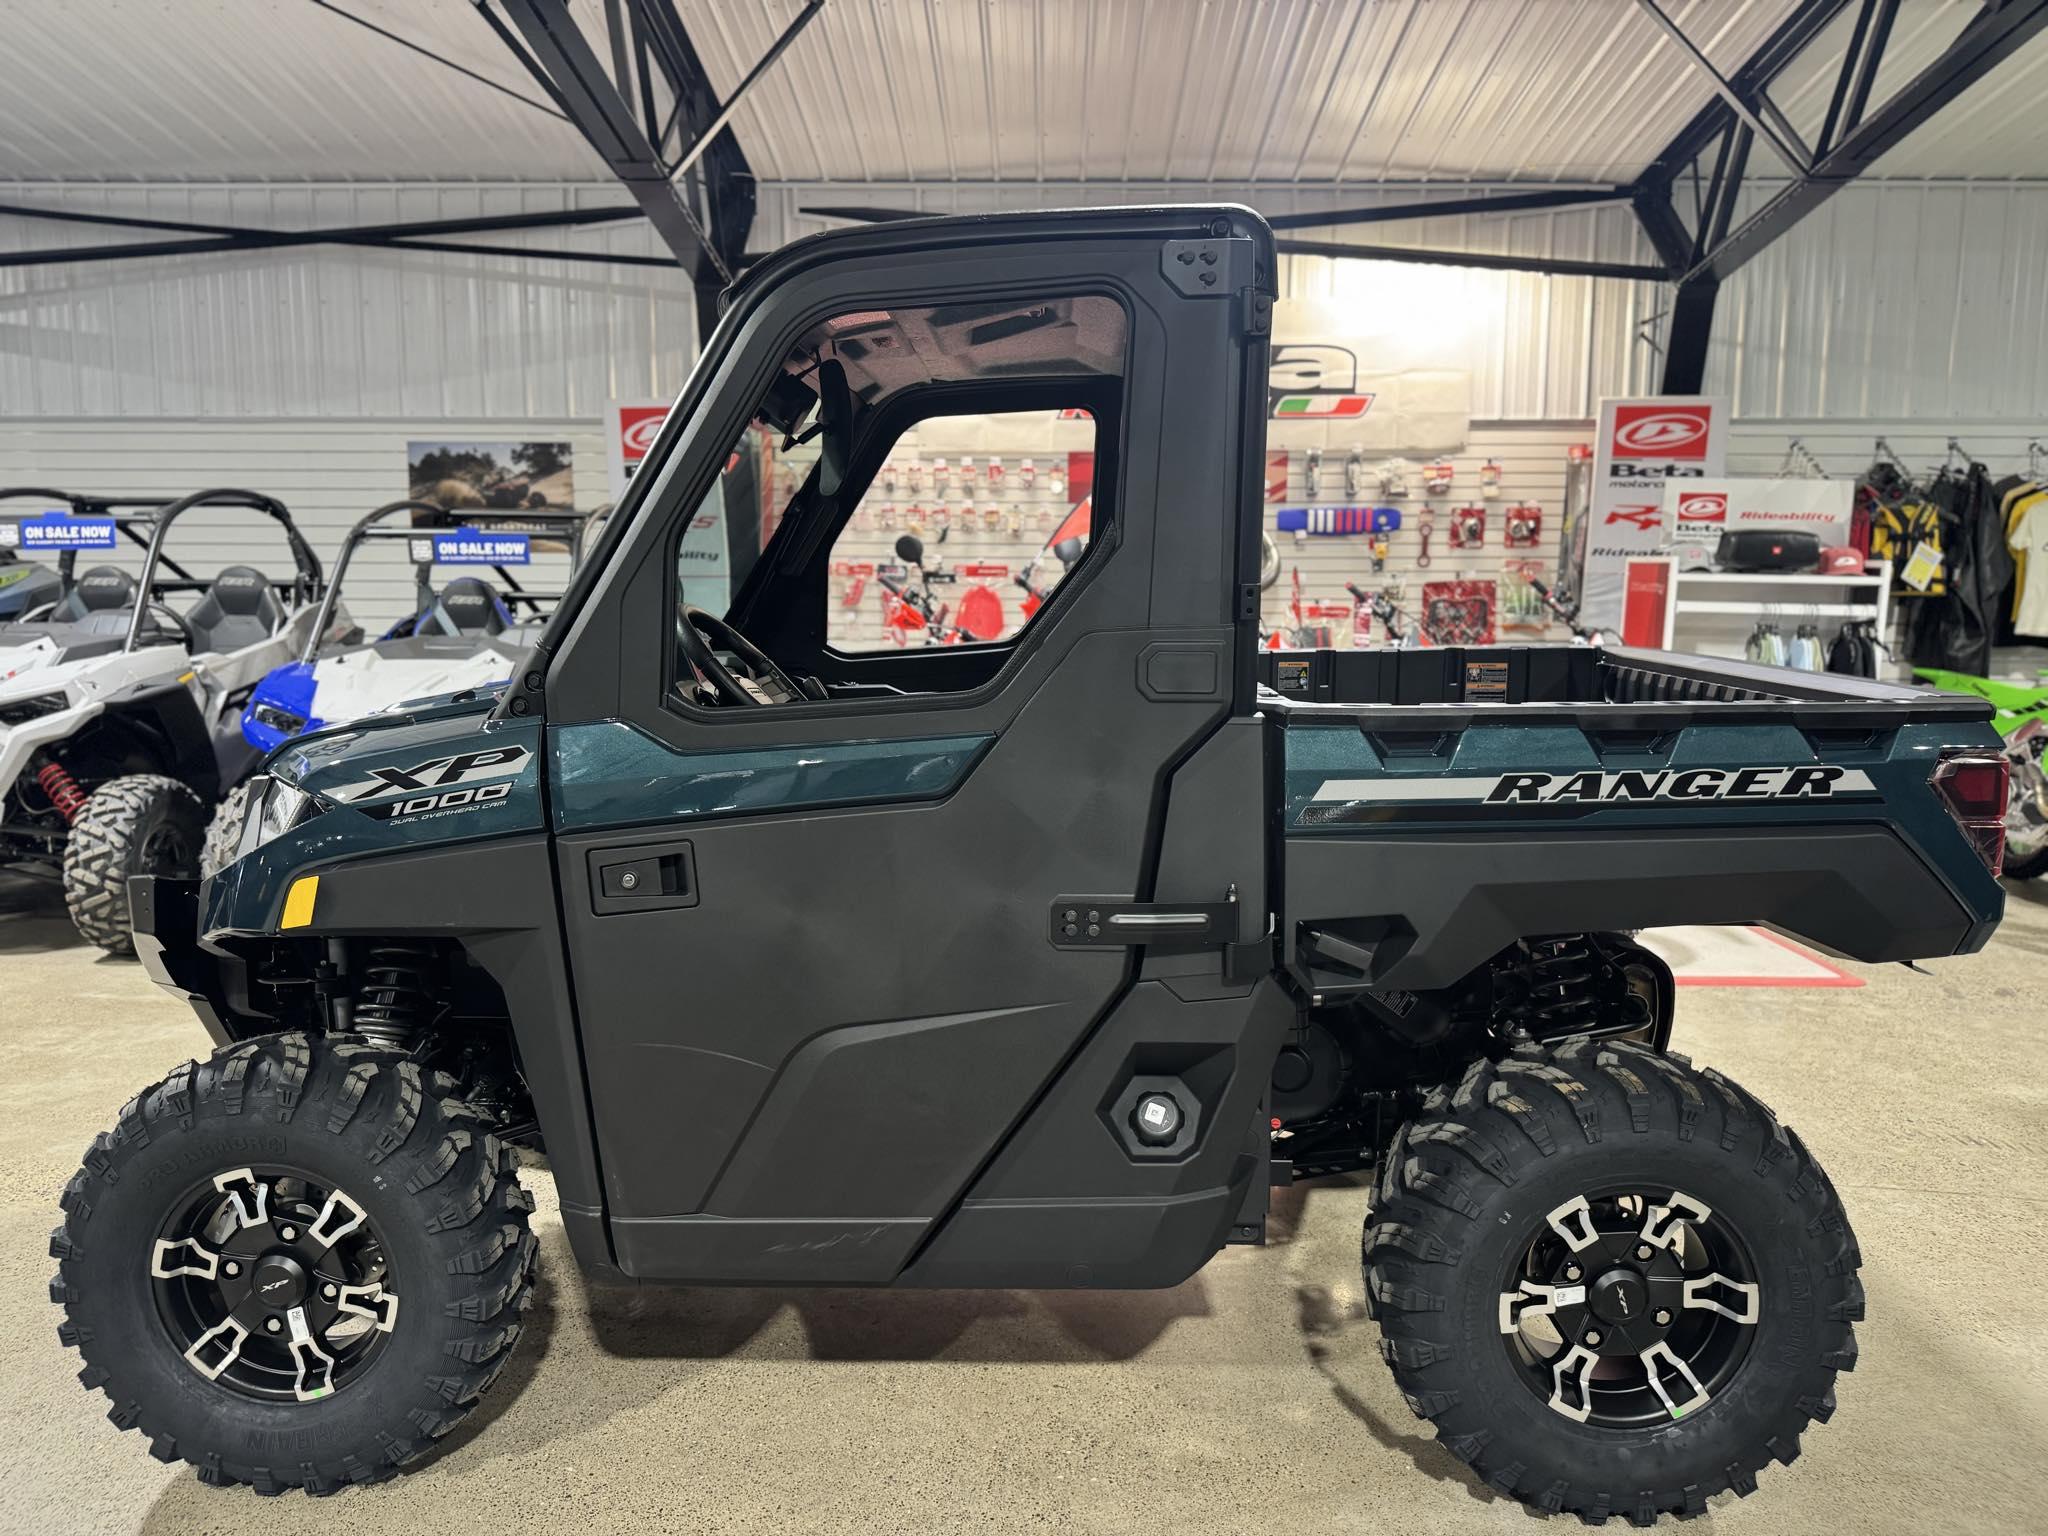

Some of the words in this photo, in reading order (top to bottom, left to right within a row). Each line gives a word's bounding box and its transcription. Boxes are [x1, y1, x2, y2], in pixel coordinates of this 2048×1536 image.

[1610, 463, 1705, 478] Beta
[1740, 511, 1836, 523] Rideability
[25, 526, 43, 539] ON
[45, 525, 79, 539] SALE
[81, 525, 111, 539] NOW
[438, 542, 456, 555] ON
[459, 542, 493, 555] SALE
[495, 542, 525, 555] NOW
[350, 745, 527, 801] XP
[1484, 766, 1845, 803] RANGER
[390, 782, 513, 817] 1000
[389, 815, 418, 826] DUAL
[421, 805, 480, 820] OVERHEAD
[482, 800, 507, 809] CAM
[260, 1279, 289, 1293] XP
